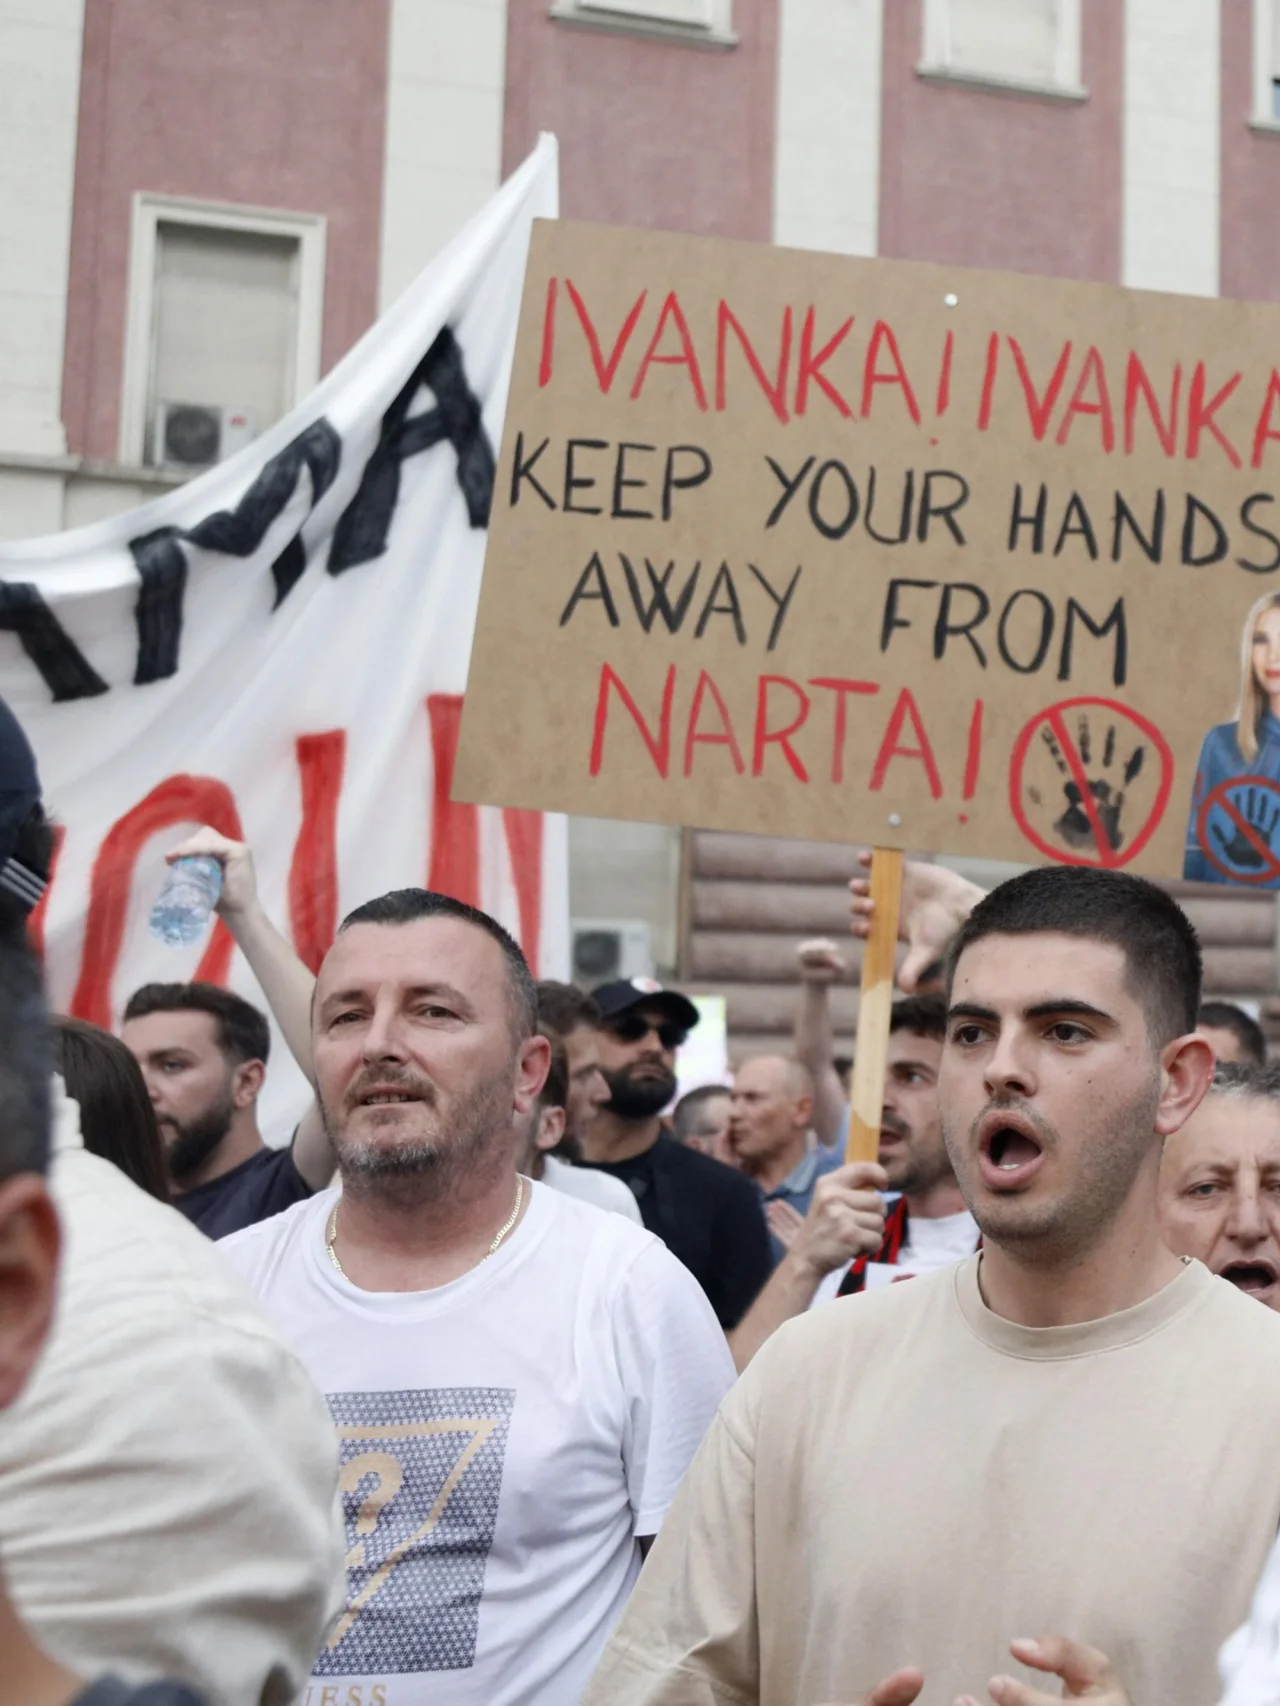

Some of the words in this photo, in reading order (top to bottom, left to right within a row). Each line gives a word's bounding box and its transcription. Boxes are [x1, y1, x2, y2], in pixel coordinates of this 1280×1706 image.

[510, 431, 712, 521] KEEP
[765, 456, 970, 545] YOUR
[560, 551, 801, 651] AWAY
[880, 578, 1128, 686] FROM
[589, 662, 984, 823] NARTA!
